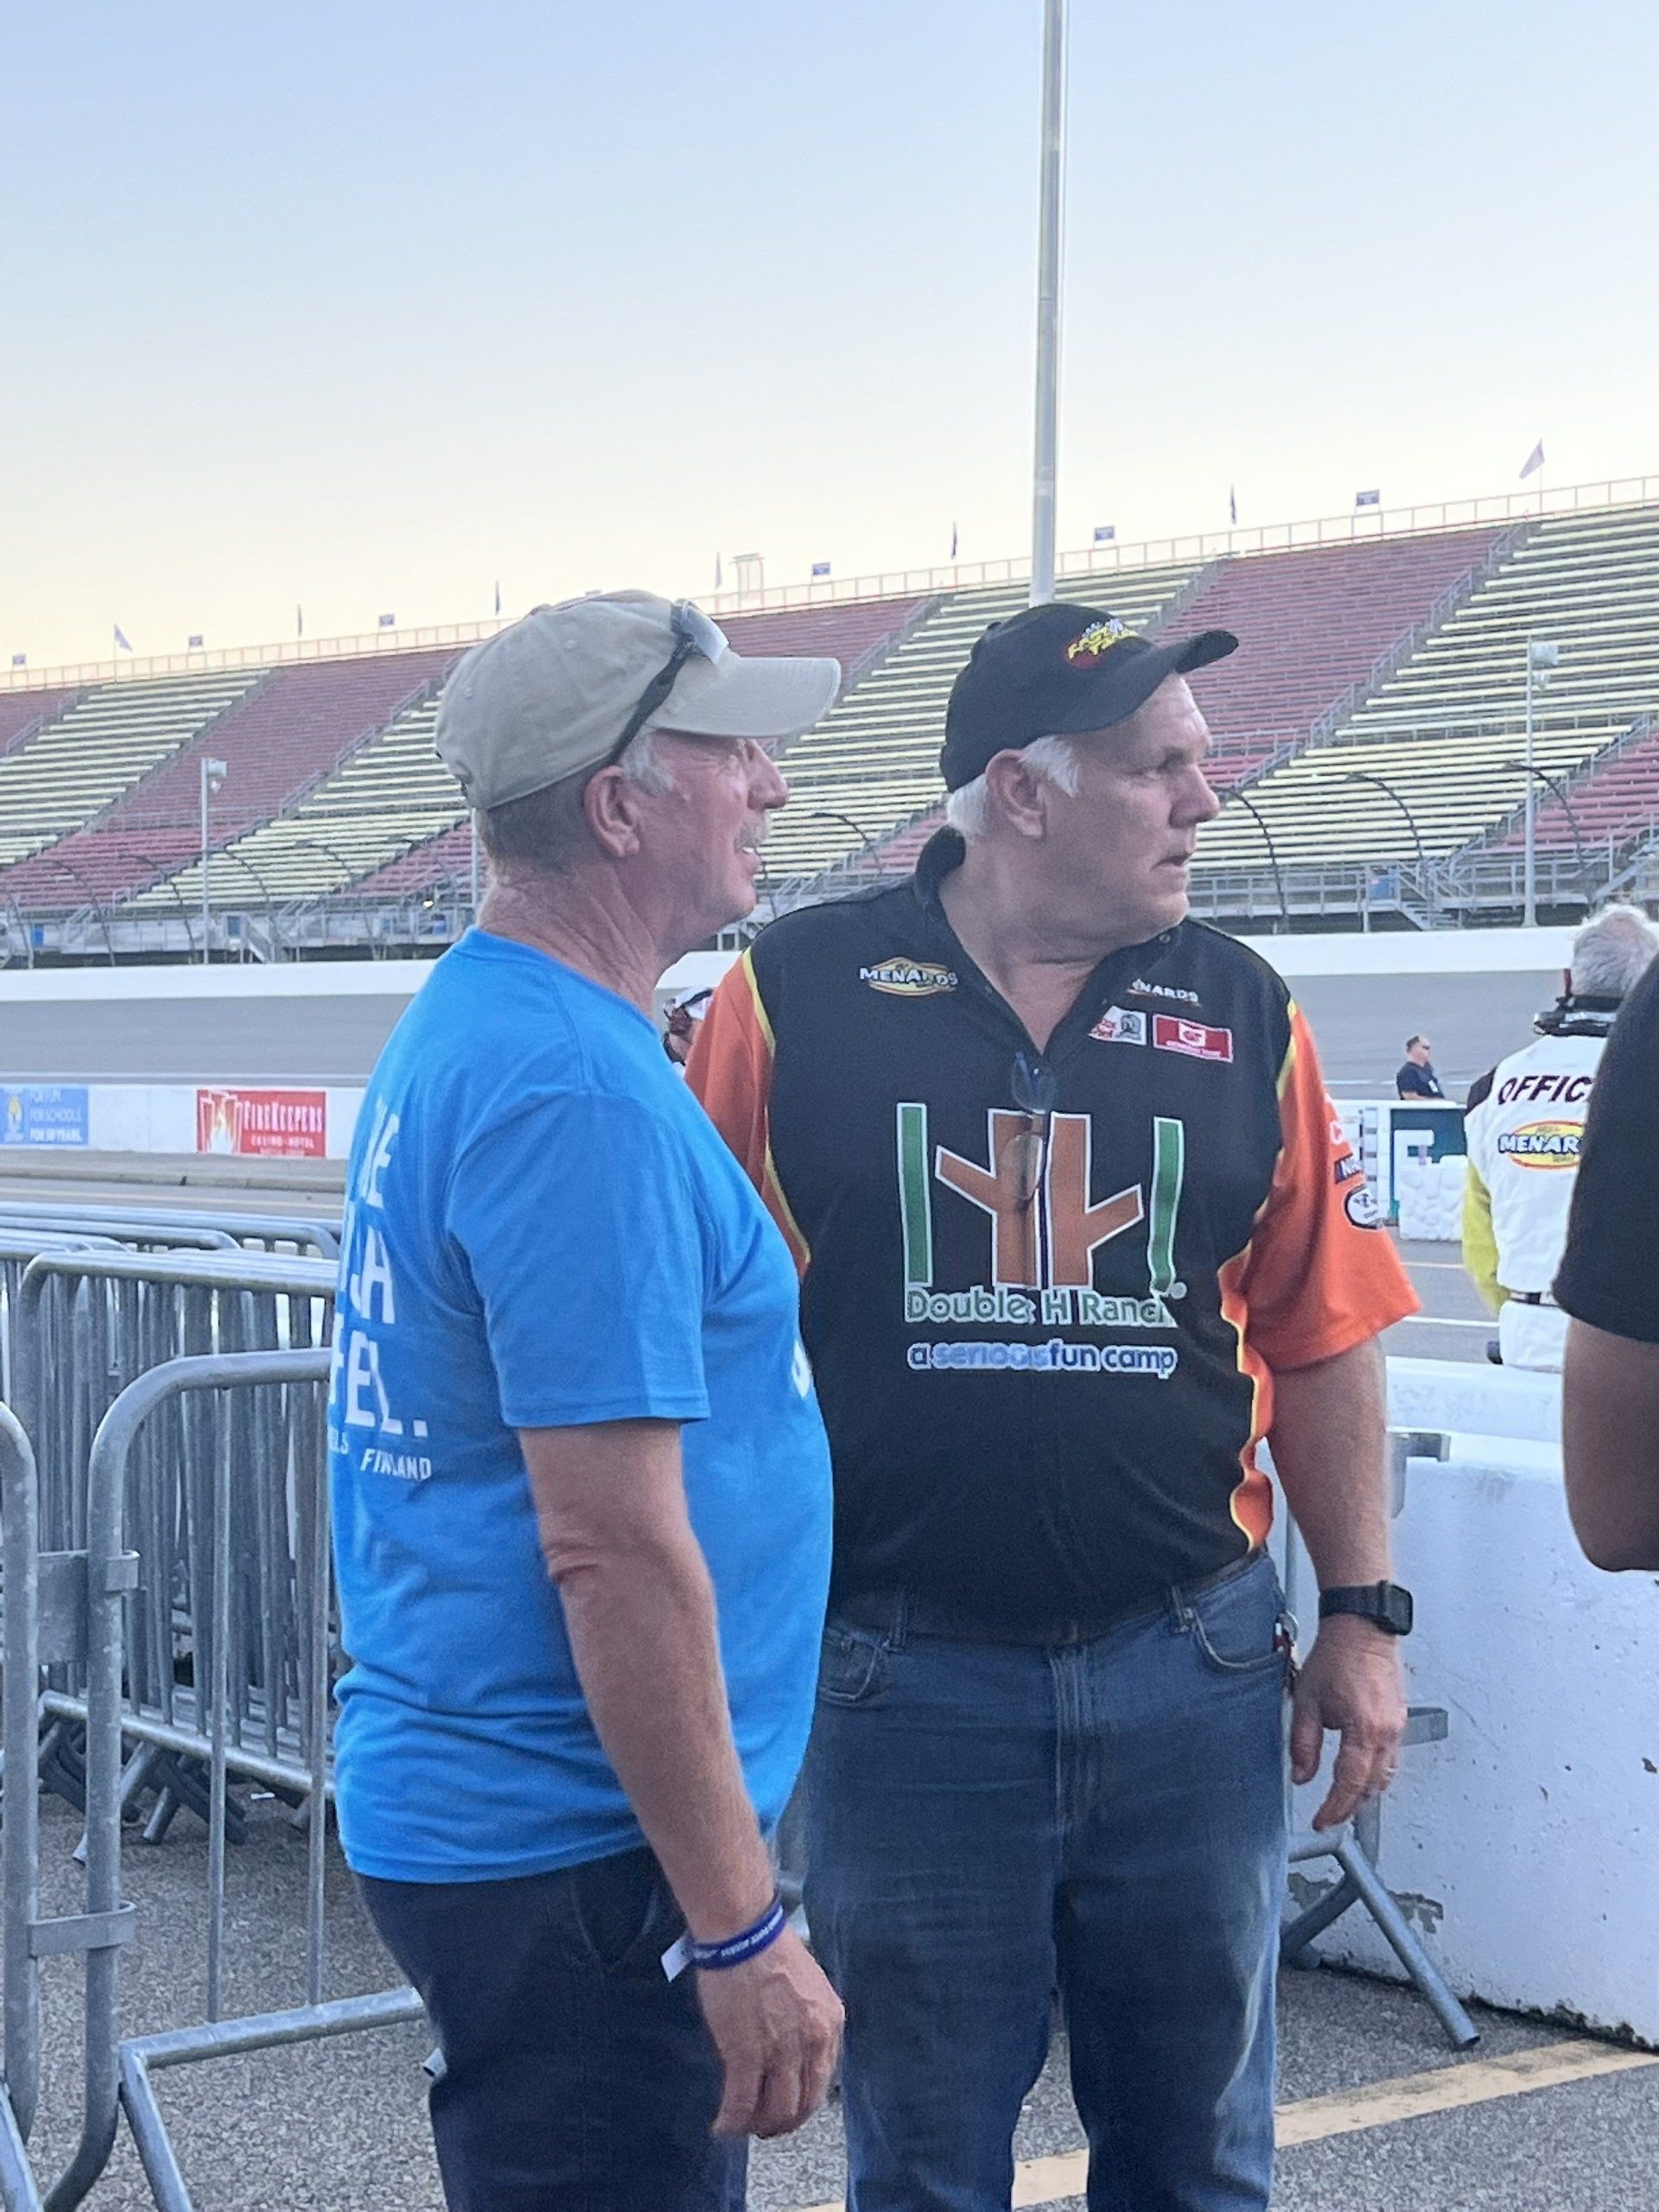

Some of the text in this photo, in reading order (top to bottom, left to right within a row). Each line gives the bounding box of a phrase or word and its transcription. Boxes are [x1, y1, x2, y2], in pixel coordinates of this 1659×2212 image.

[906, 1286, 1035, 1323] Double
[1041, 1287, 1074, 1325] H
[1102, 1345, 1178, 1378] camp
[360, 1448, 431, 1480] FINLAND
